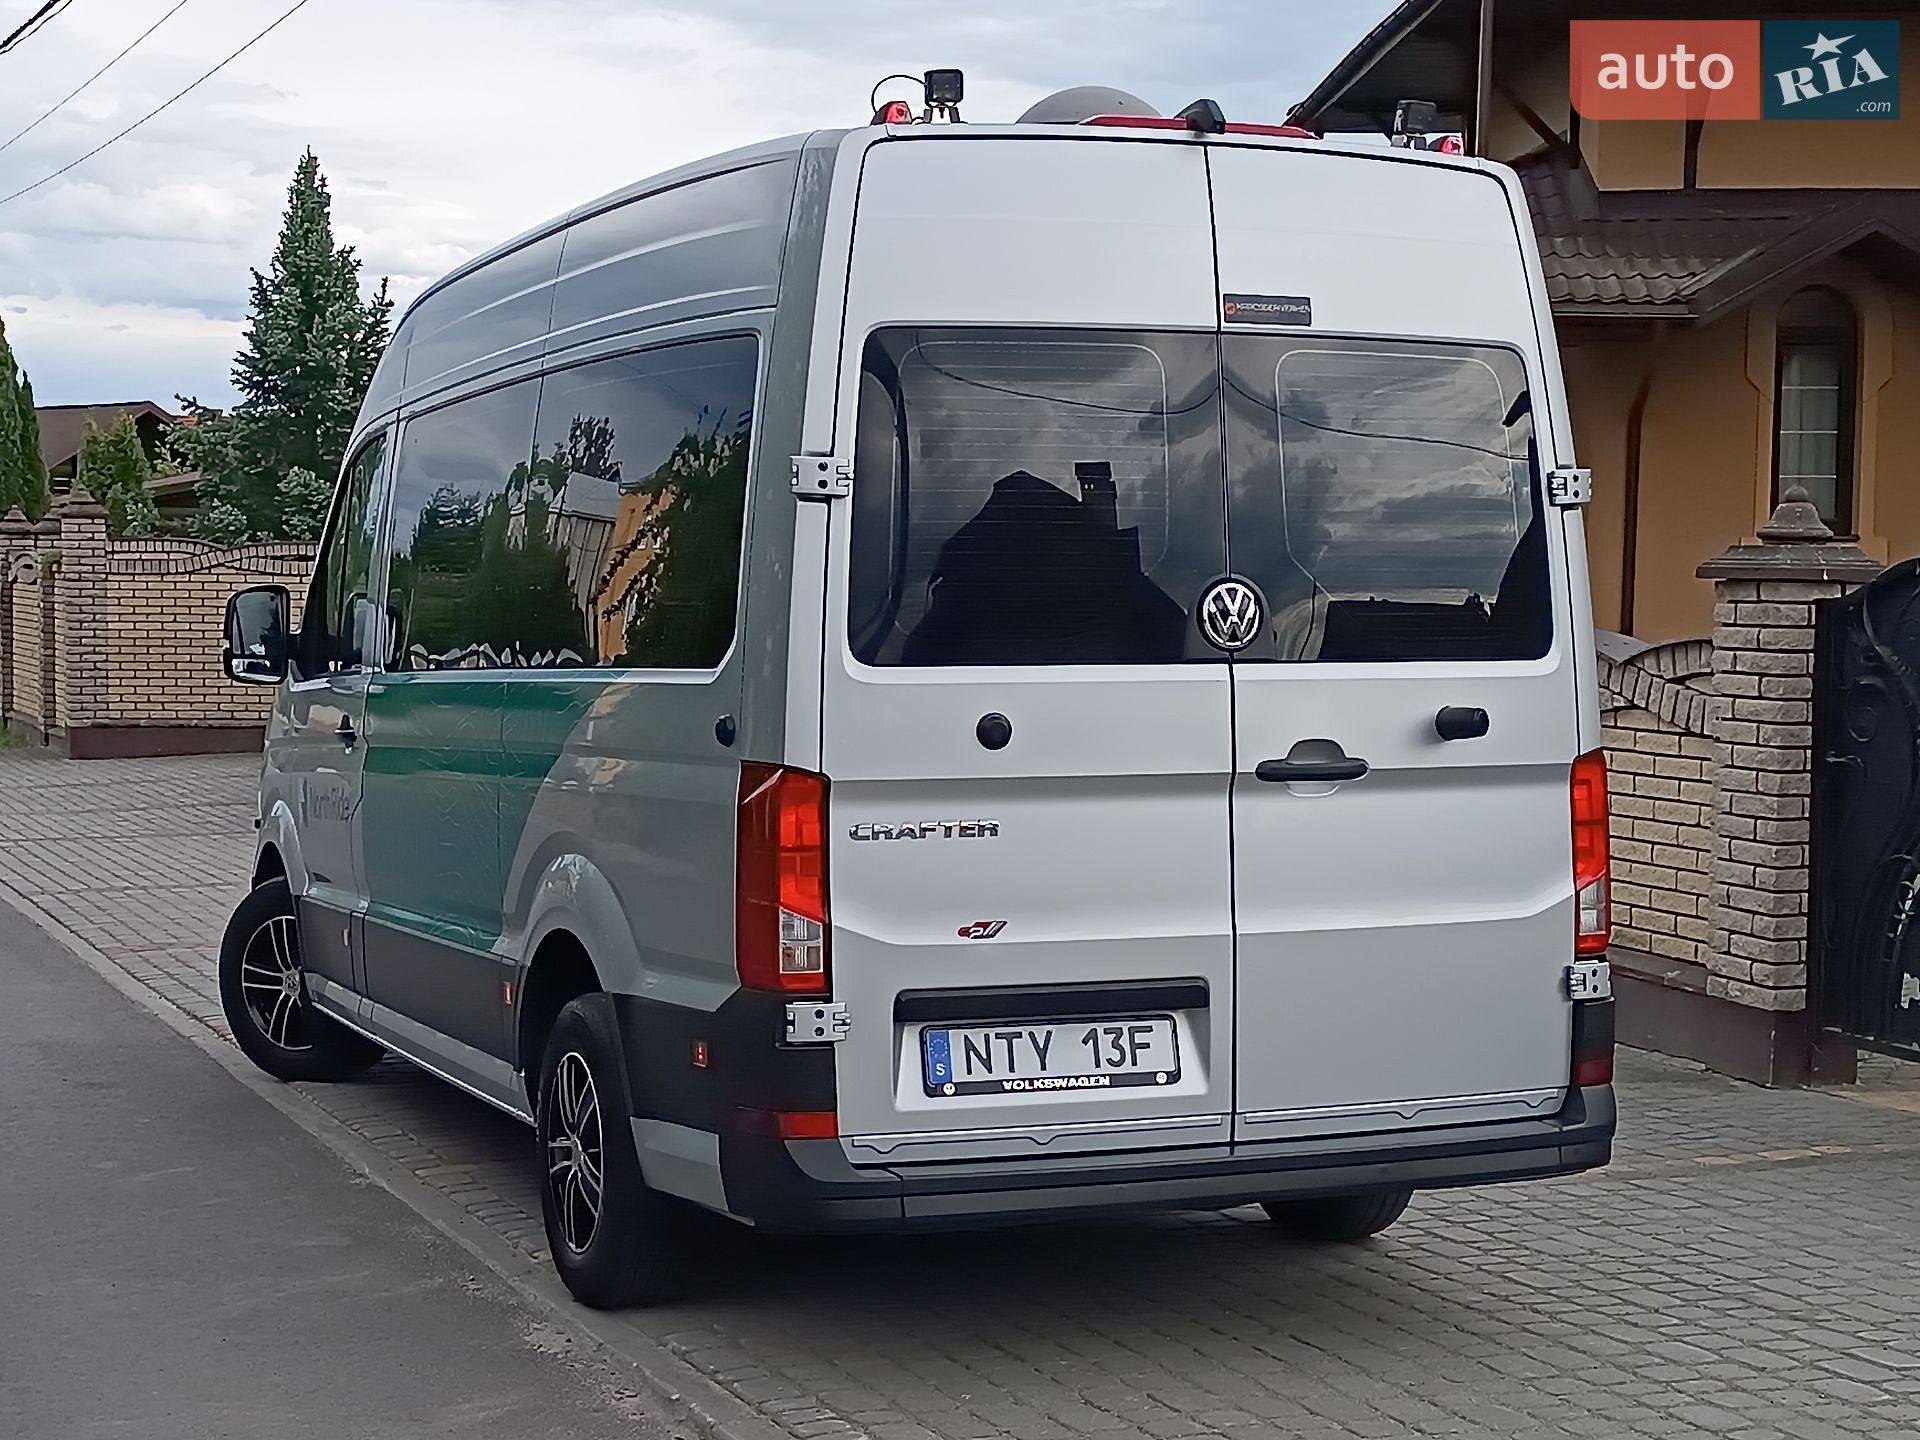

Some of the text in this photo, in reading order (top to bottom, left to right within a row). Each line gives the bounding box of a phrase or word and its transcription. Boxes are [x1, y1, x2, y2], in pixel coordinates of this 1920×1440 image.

[849, 820, 1000, 841] CRAFTER
[963, 1026, 1153, 1076] NTY 13F
[936, 1063, 945, 1076] S
[1002, 1075, 1110, 1091] VOLKSWAGEN
